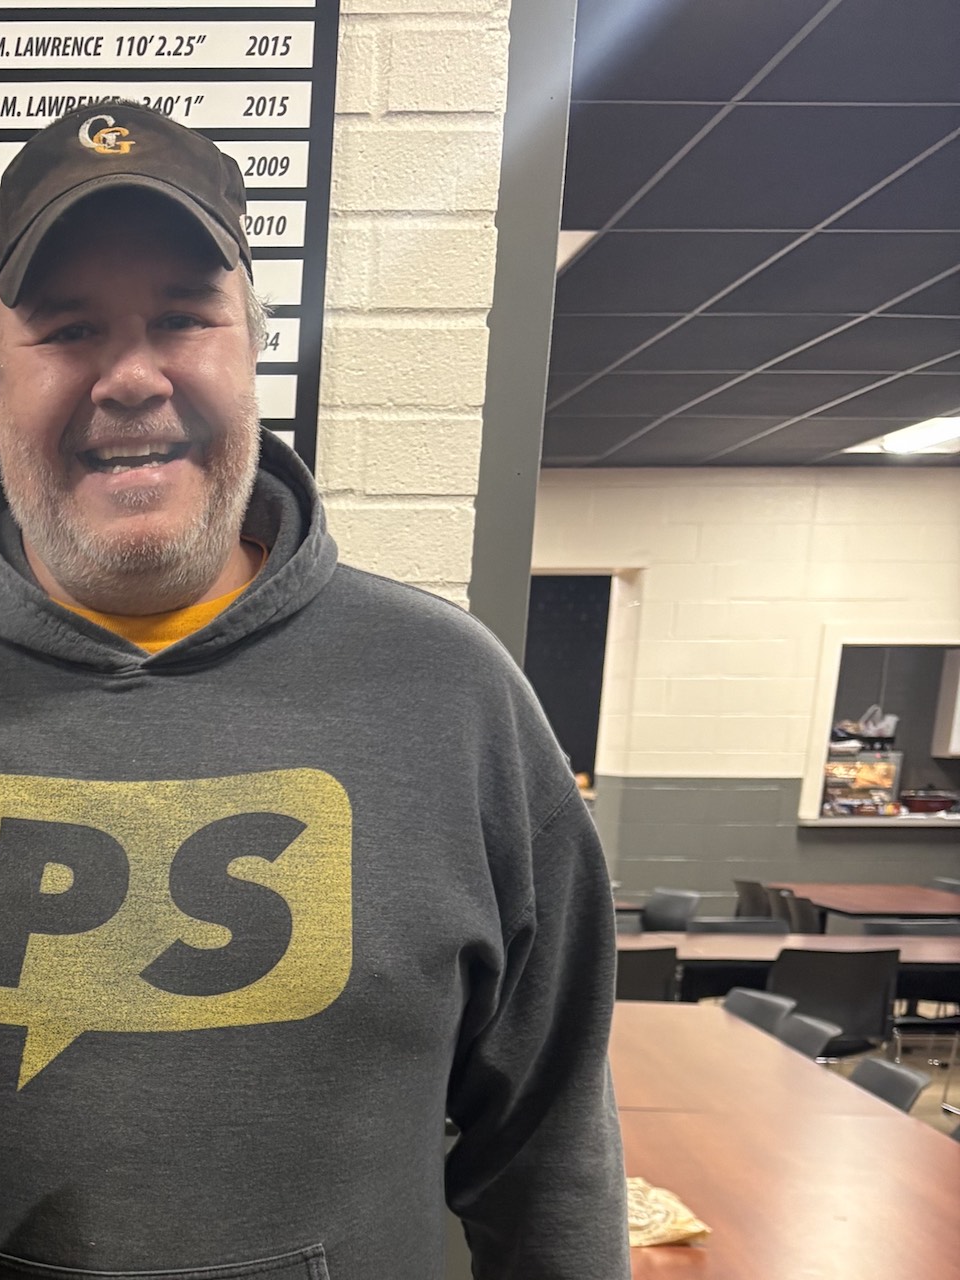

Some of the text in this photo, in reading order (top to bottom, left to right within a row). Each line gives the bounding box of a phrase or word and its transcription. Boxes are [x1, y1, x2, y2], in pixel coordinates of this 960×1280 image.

[14, 36, 104, 57] LAWRENCE
[246, 36, 292, 56] 2015
[0, 96, 22, 116] M.
[242, 96, 289, 116] 2015
[244, 156, 290, 177] 2009
[244, 215, 287, 236] 2010
